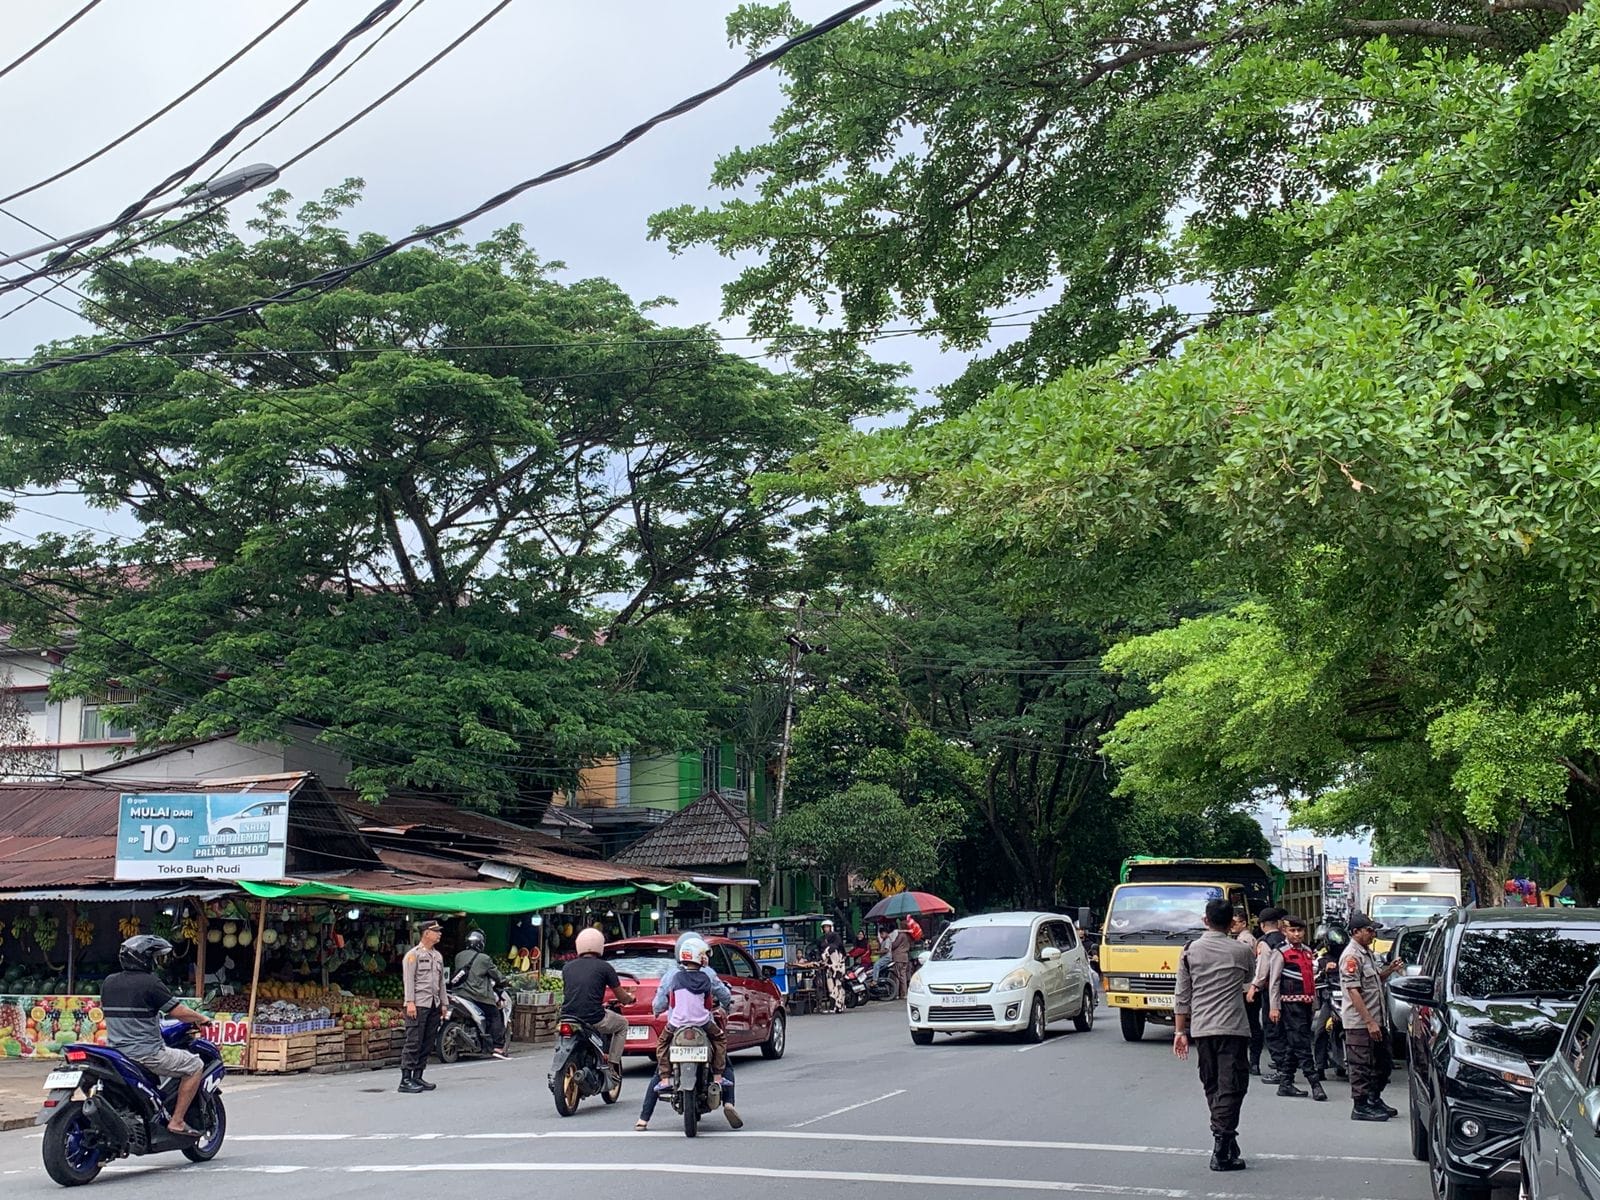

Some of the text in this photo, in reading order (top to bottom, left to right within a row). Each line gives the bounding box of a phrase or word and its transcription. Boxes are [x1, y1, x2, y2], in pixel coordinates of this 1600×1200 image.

[130, 807, 193, 818] MULAI DARI
[128, 836, 139, 844] RP
[140, 824, 176, 852] 10
[195, 844, 266, 857] PALING HEMAT
[157, 864, 241, 874] Toko Buah Rudi
[1367, 876, 1379, 884] AF
